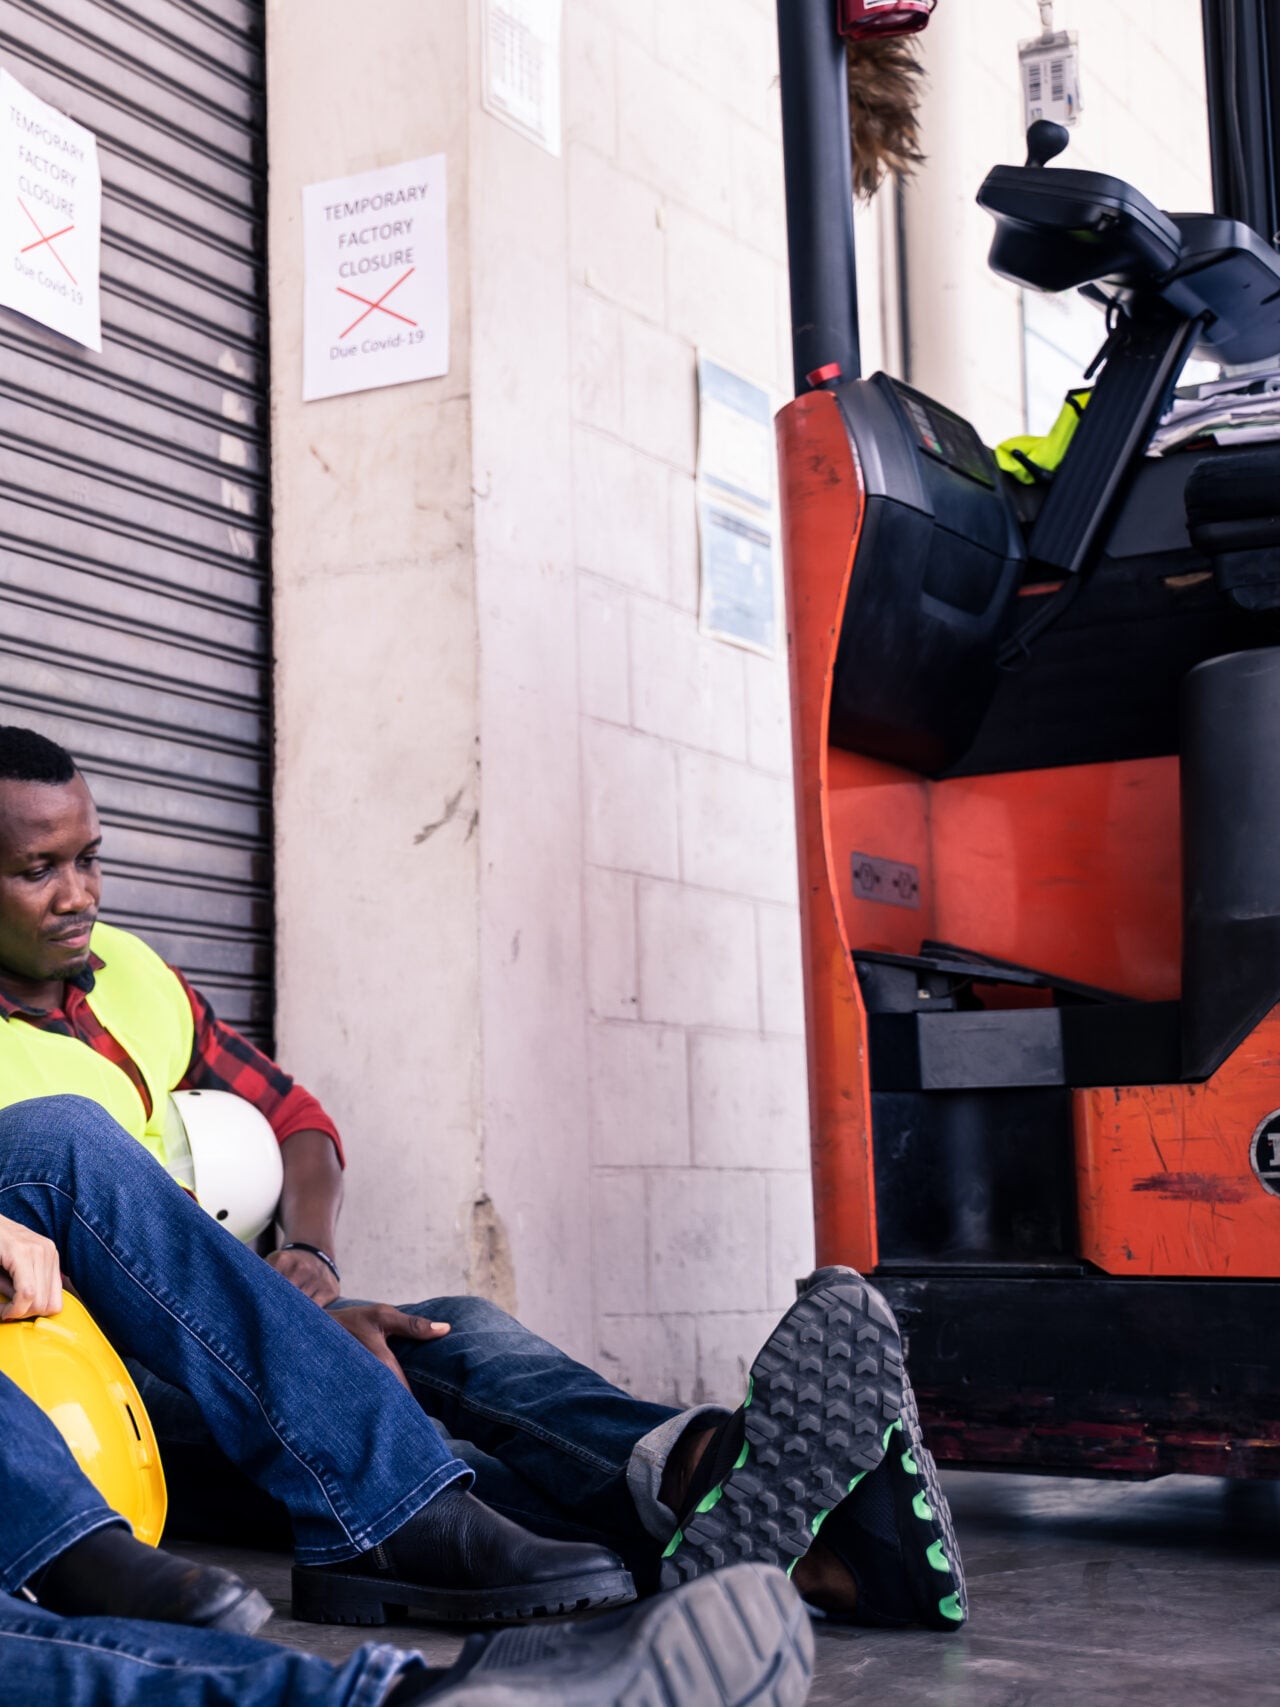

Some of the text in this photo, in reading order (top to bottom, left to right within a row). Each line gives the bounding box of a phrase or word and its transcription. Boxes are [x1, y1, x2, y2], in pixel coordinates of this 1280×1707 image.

[9, 105, 85, 163] TEMPORARY
[18, 145, 77, 189] FACTORY
[18, 175, 75, 220] CLOSURE
[324, 184, 428, 222] TEMPORARY
[338, 219, 414, 249] FACTORY
[338, 247, 415, 279] CLOSURE
[329, 330, 425, 361] Due Covid-19
